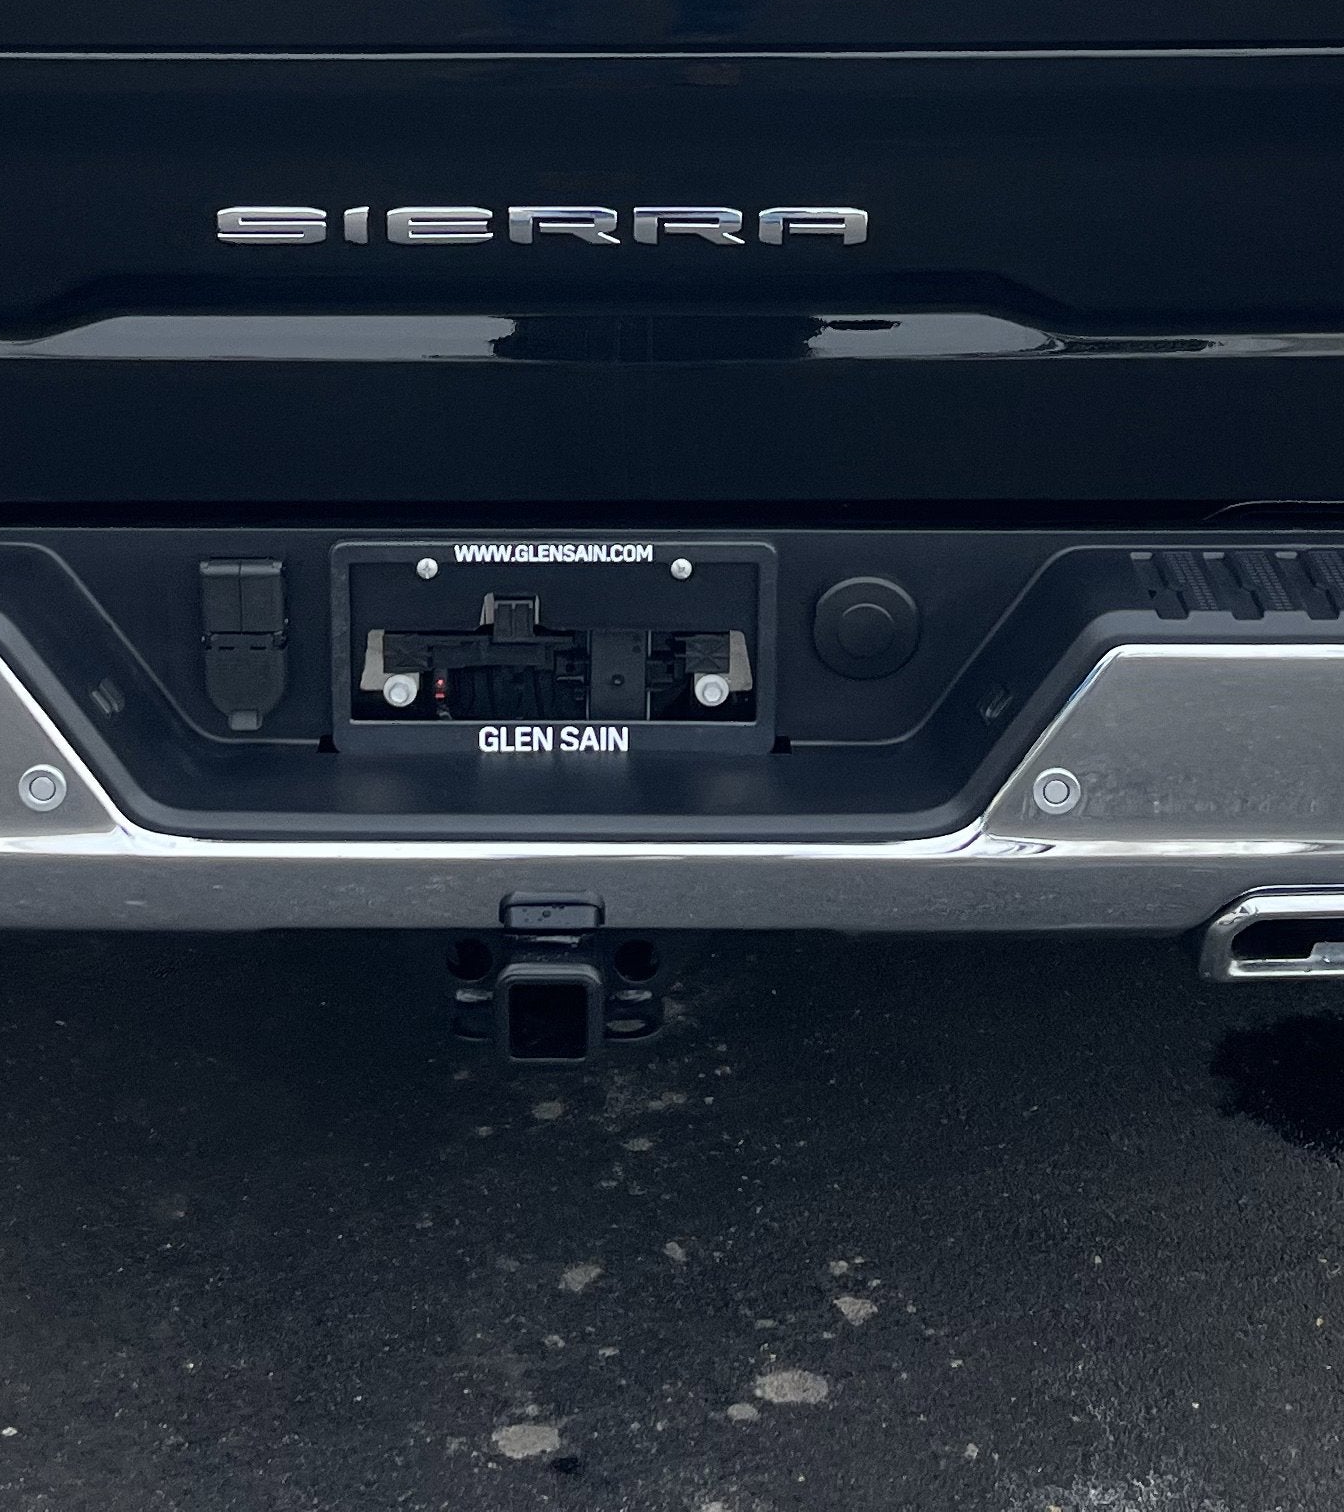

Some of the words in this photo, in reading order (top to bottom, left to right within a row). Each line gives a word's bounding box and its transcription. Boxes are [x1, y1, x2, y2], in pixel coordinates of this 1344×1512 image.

[216, 205, 869, 246] SIERRA
[454, 544, 654, 563] WWW.GLENSAIN.COM
[478, 726, 554, 752] GLEN
[559, 726, 629, 752] SAIN
